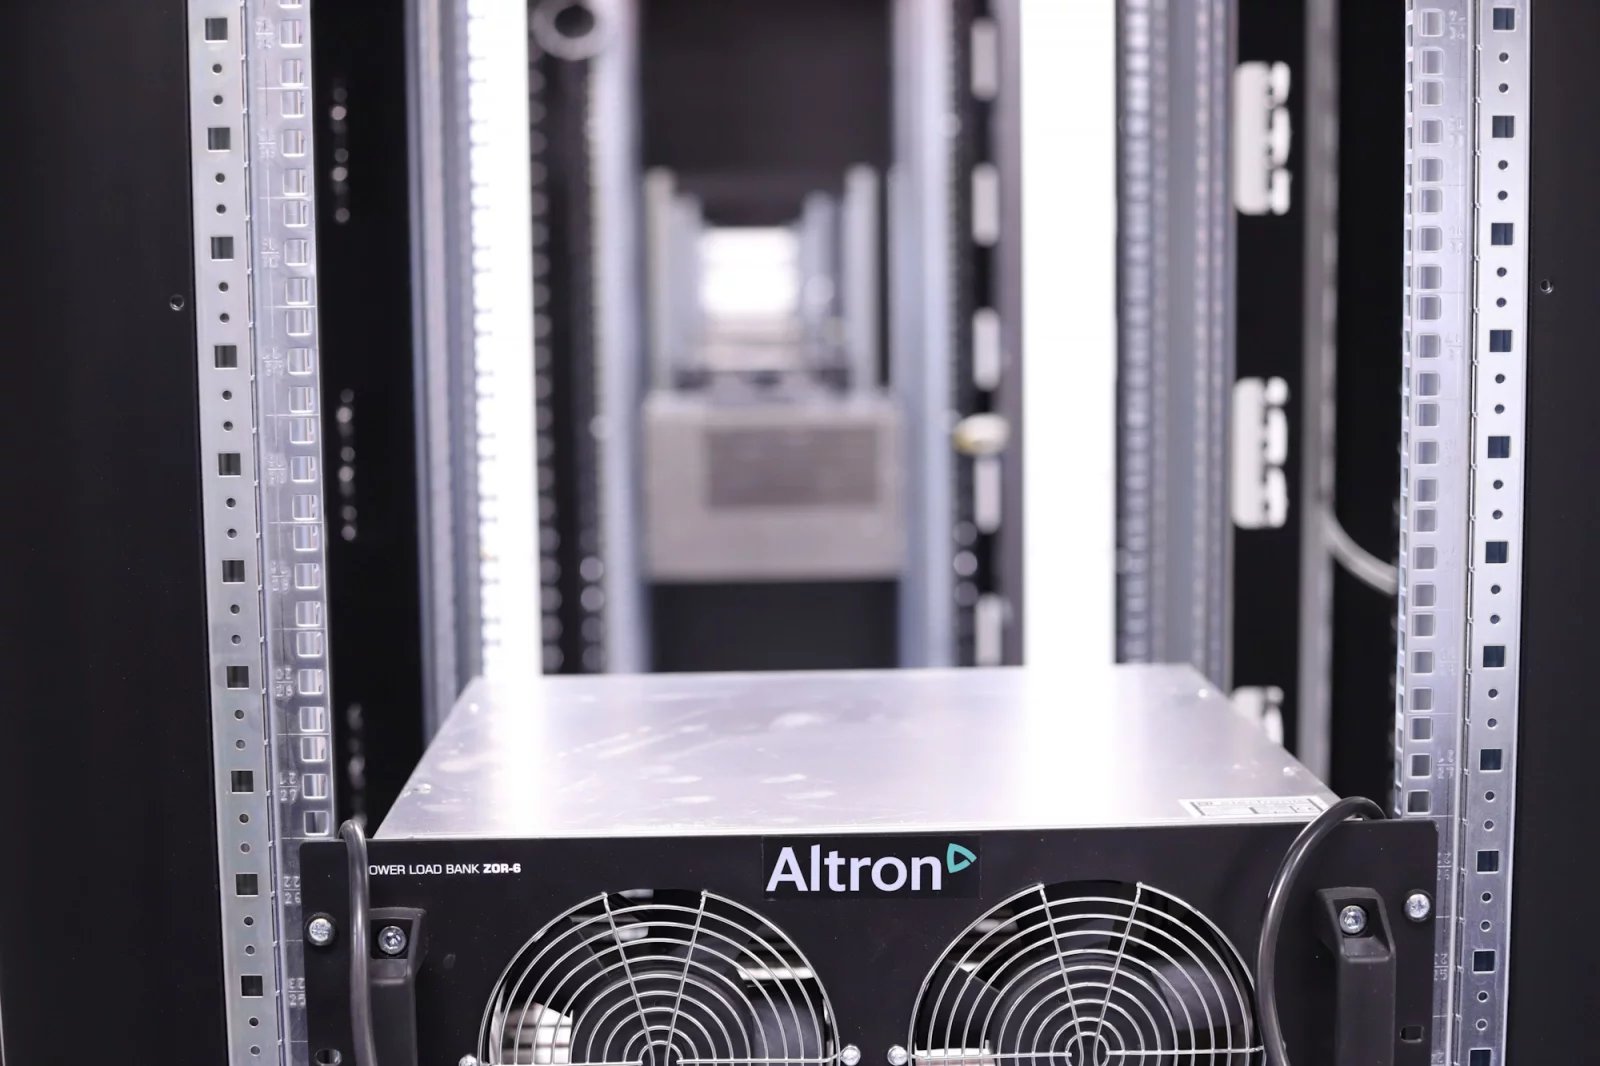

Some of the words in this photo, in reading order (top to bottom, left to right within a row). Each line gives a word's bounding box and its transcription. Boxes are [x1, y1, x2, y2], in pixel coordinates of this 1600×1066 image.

[279, 789, 298, 801] 27
[368, 864, 406, 876] OWER
[409, 864, 442, 875] LOAD
[446, 863, 480, 875] BANK
[483, 863, 522, 874] ZOR-6
[766, 844, 942, 892] Altron
[283, 891, 301, 904] 26
[288, 993, 306, 1006] 25
